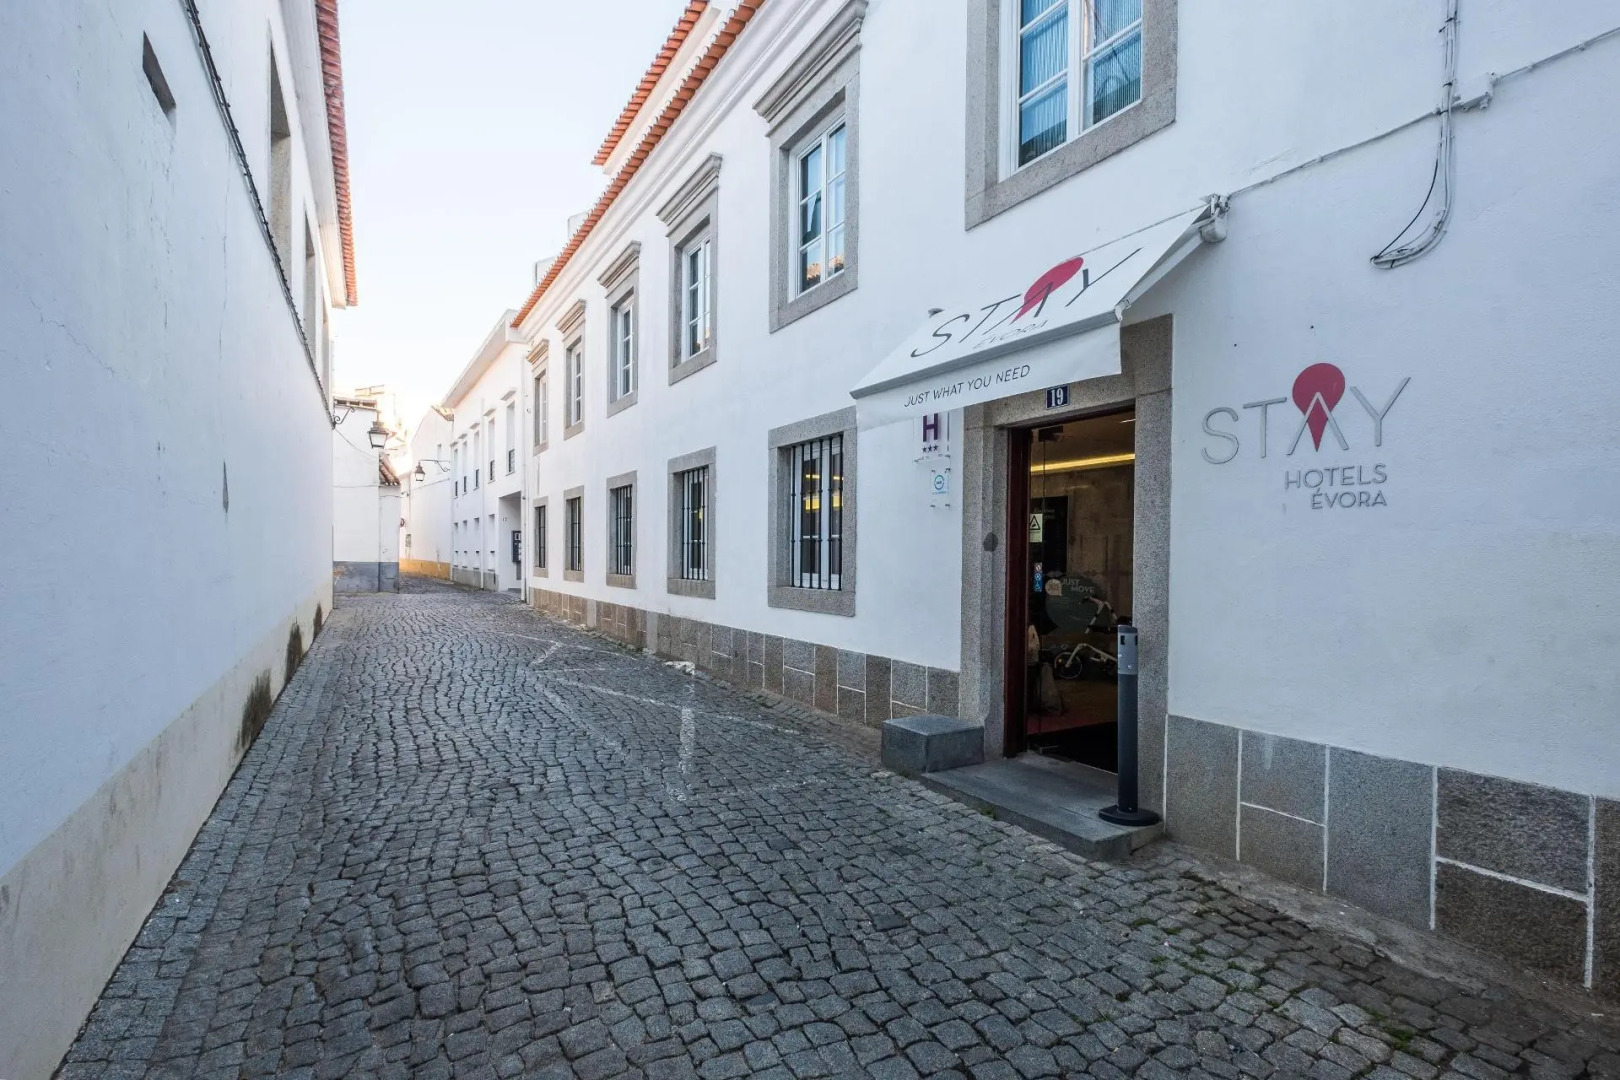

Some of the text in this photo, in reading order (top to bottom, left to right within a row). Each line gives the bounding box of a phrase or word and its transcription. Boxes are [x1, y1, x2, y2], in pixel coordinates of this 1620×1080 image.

[910, 247, 1144, 358] STAY
[904, 364, 1031, 407] JUST WHAT YOU NEED
[1050, 387, 1064, 408] 19
[922, 413, 939, 442] H
[1201, 377, 1411, 464] STAY
[1285, 463, 1388, 489] HOTELS
[1311, 488, 1388, 509] ÉVORA
[1071, 585, 1095, 594] MOVE
